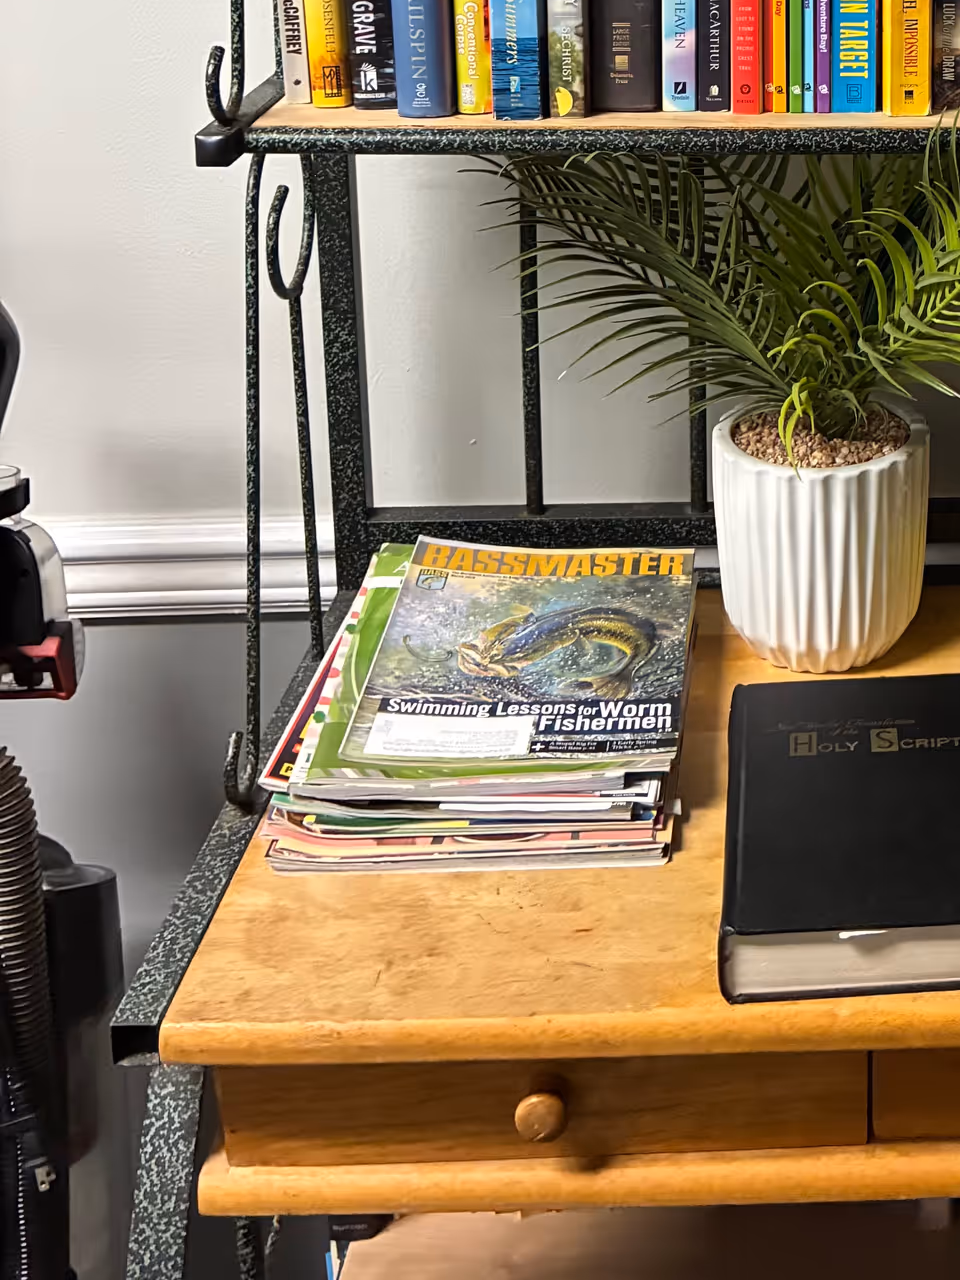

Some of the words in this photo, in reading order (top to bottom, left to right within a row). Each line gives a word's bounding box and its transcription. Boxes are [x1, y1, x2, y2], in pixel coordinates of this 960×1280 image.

[352, 0, 377, 54] GRAVE
[462, 1, 479, 80] Conventional
[839, 21, 869, 80] TARGET
[903, 18, 919, 79] IMPOSSIBLE
[561, 27, 573, 82] SECHRIST
[422, 543, 685, 577] BASSMASTER
[386, 699, 492, 718] Swimming
[496, 701, 577, 716] Lessons
[578, 704, 598, 716] for
[599, 701, 672, 718] Worm
[538, 715, 672, 732] Fishermen
[789, 732, 858, 757] HOLY
